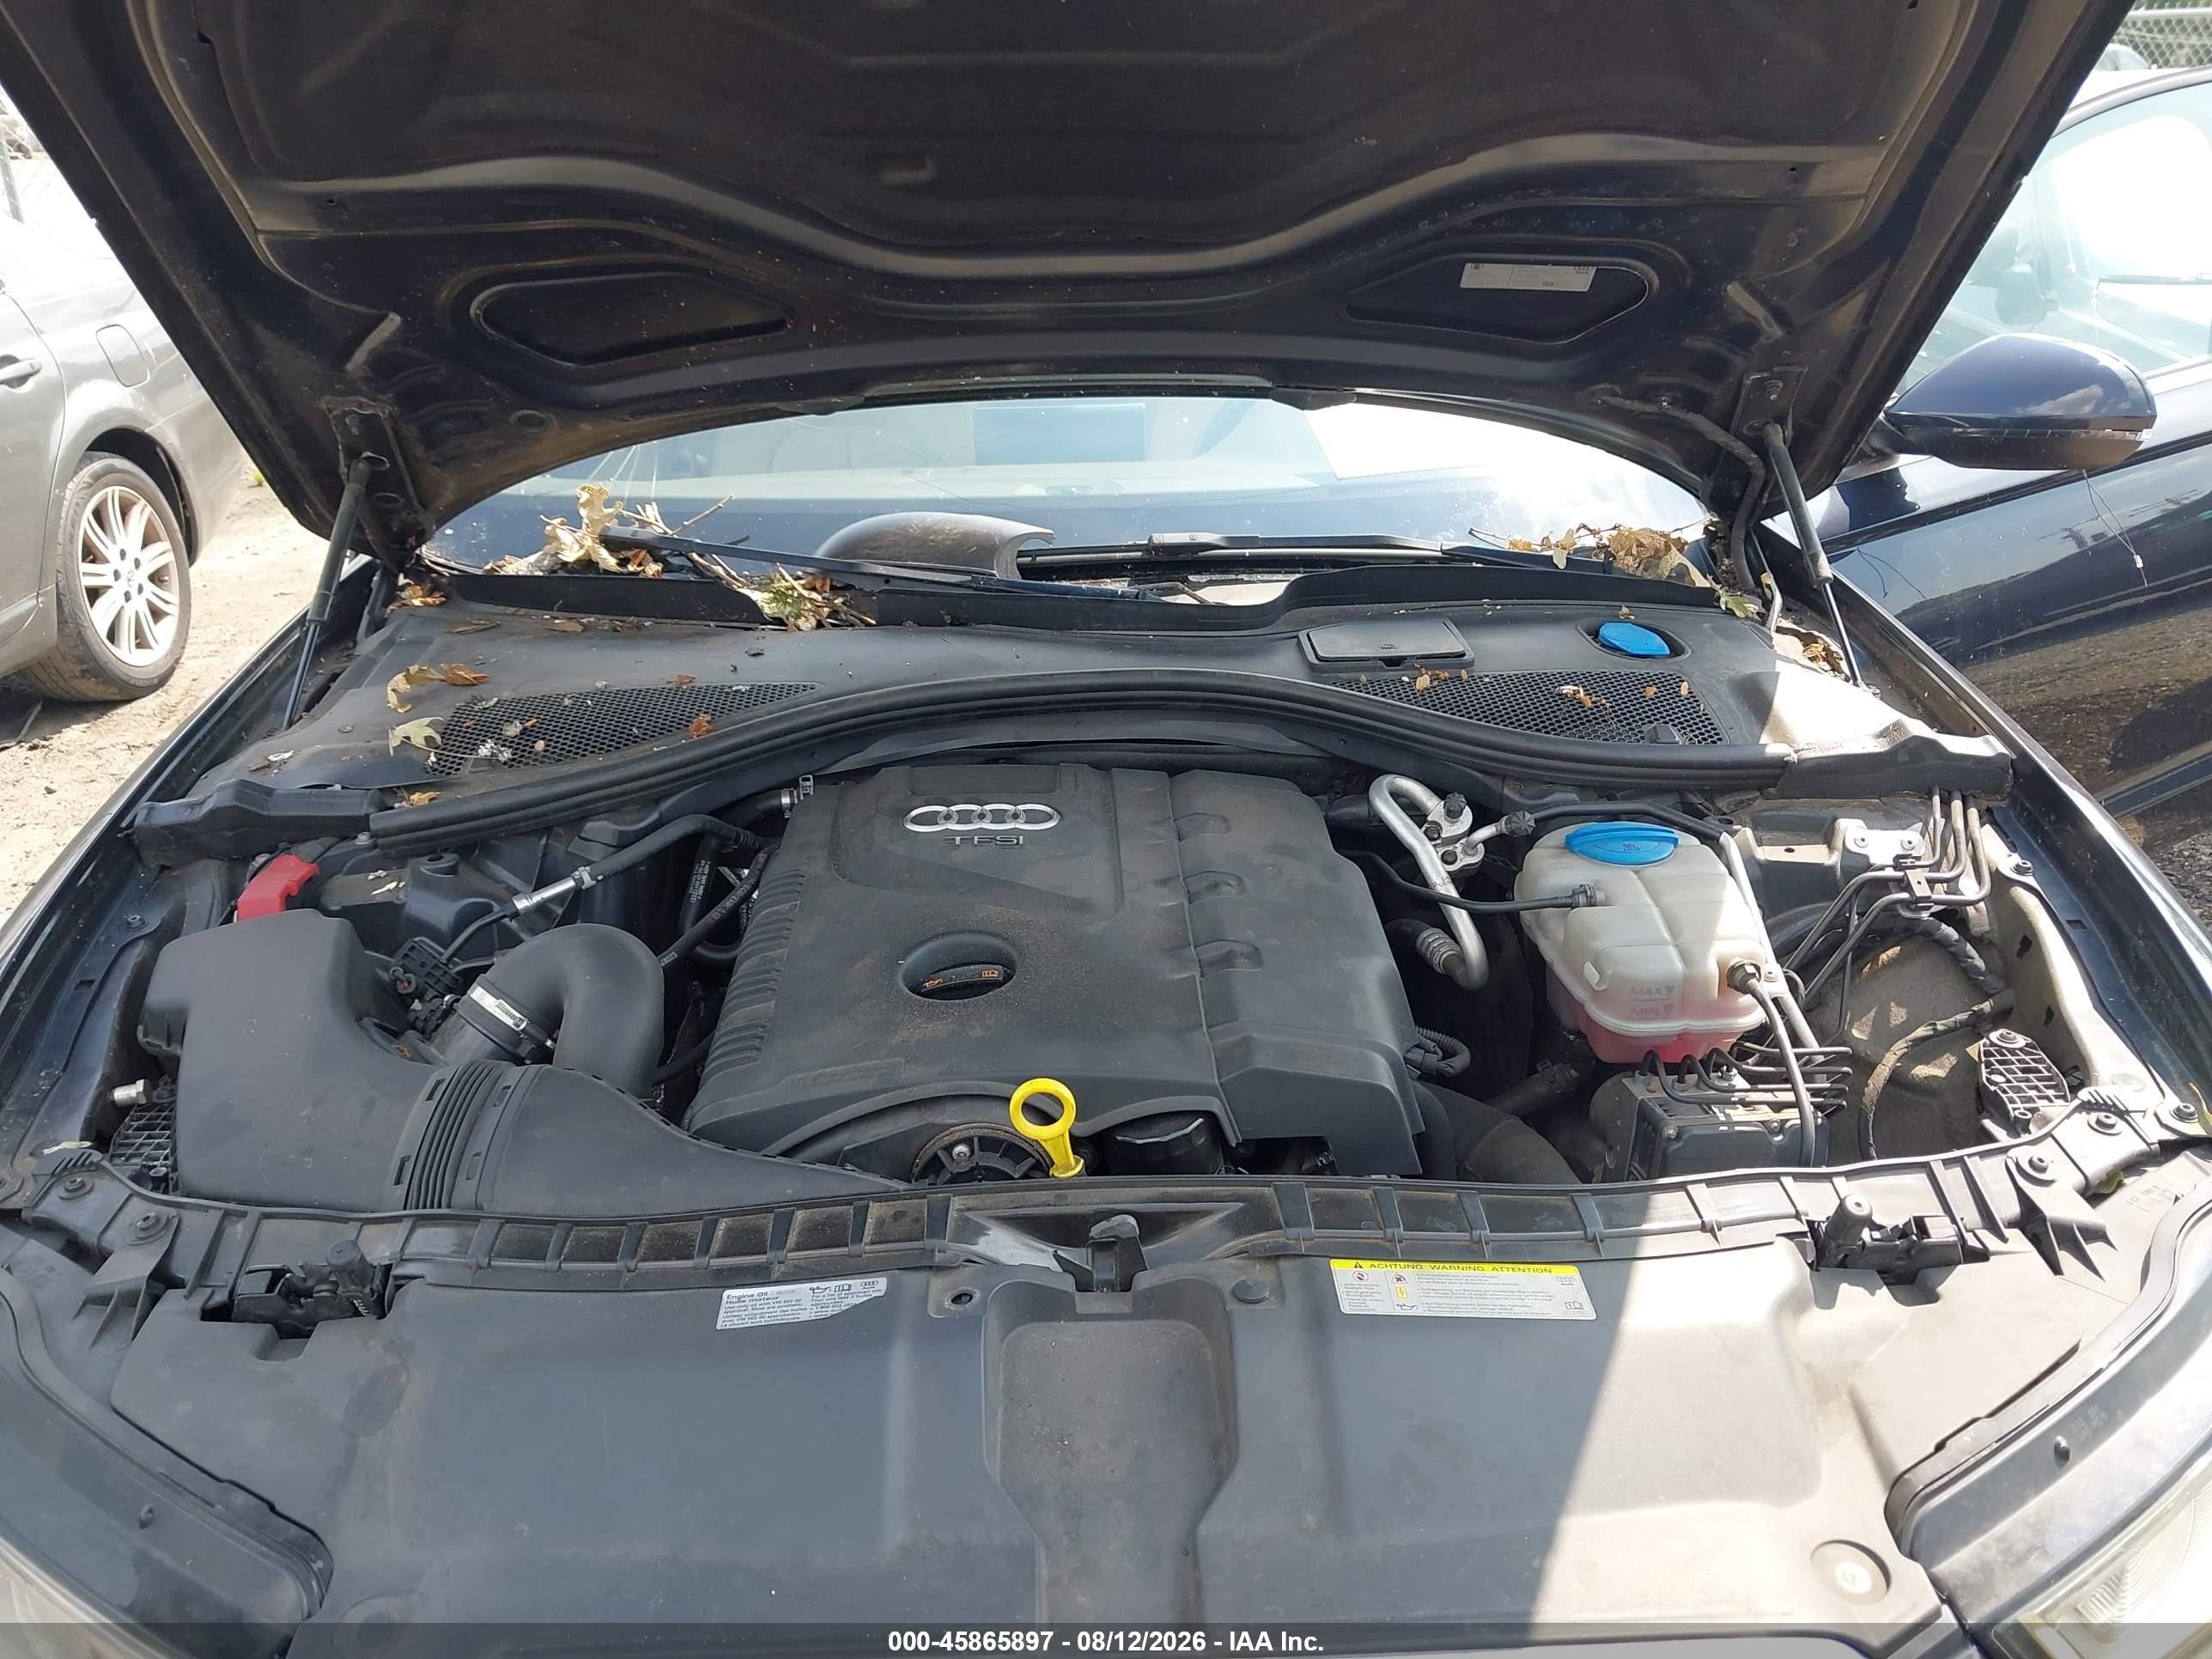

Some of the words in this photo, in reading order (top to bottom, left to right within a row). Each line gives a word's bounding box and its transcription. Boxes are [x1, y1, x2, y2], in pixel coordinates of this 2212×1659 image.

[945, 835, 1024, 846] TFSI
[1630, 987, 1662, 996] MAX
[1429, 1263, 1485, 1272] WARNING
[1491, 1265, 1552, 1273] ATTENTION
